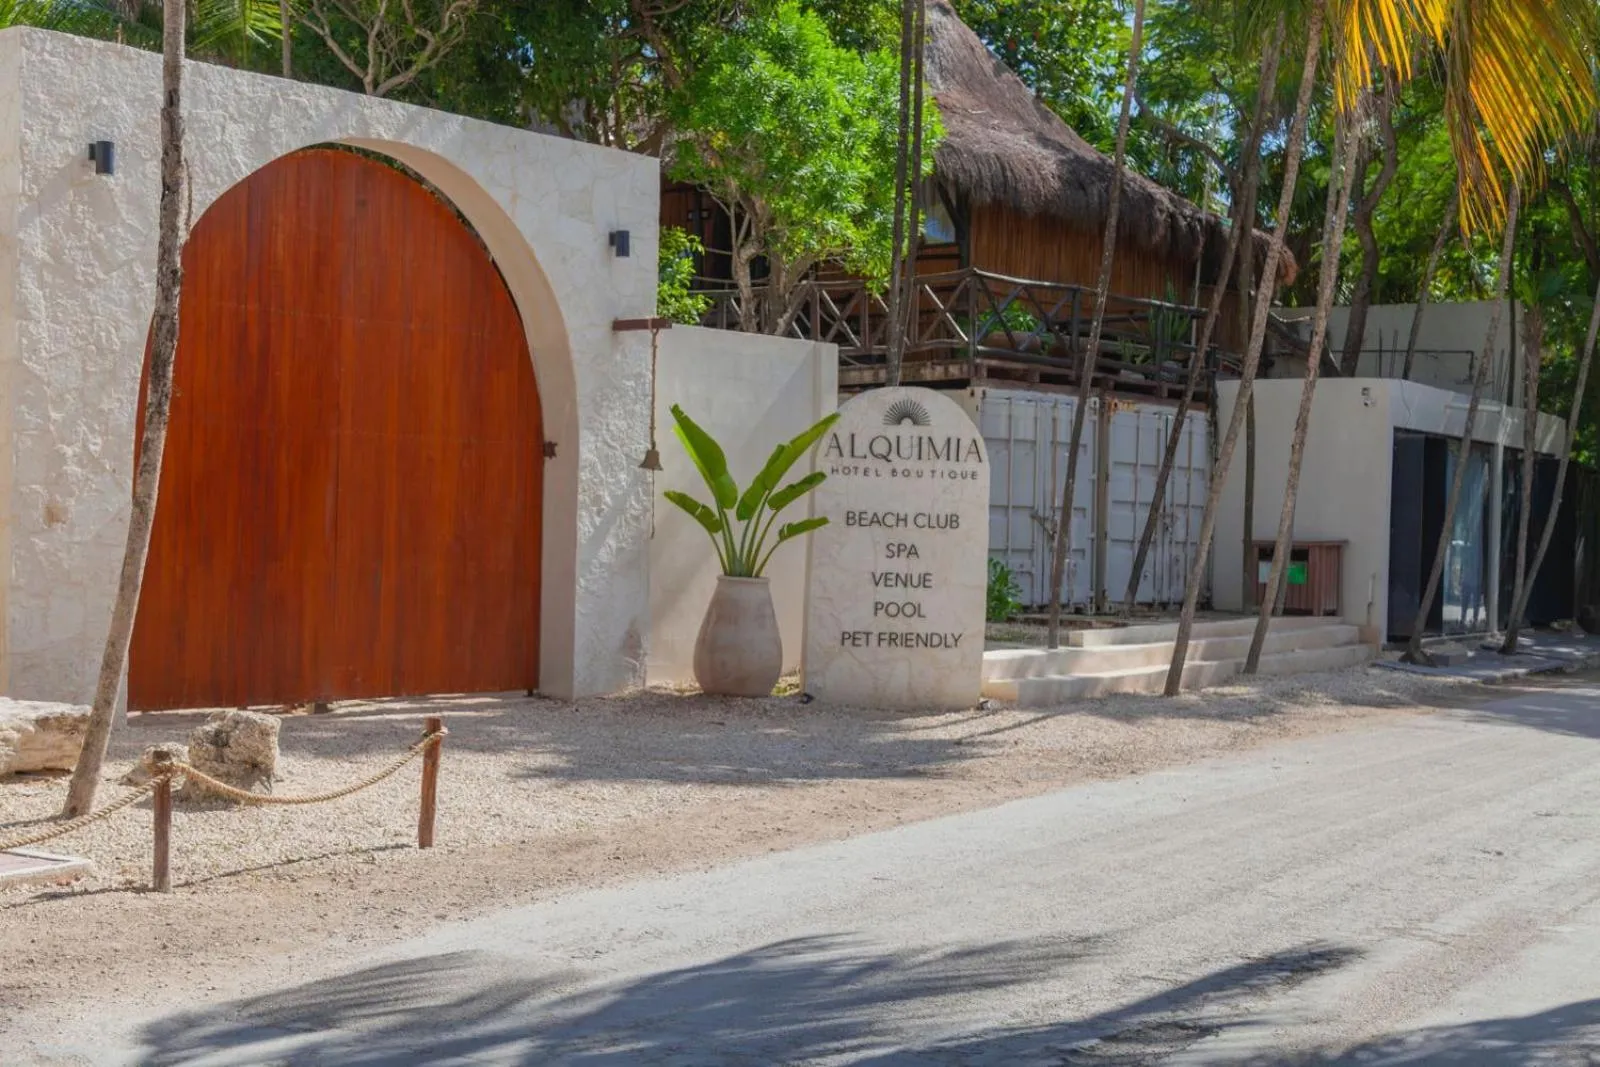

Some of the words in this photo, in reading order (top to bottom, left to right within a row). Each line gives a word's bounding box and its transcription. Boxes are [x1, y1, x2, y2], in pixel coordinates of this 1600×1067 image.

[824, 432, 983, 463] ALQUIMIA
[831, 467, 882, 478] HOTEL
[891, 468, 978, 480] BOUTIQUE
[846, 511, 908, 529] BEACH
[913, 512, 960, 530] CLUB
[885, 543, 920, 559] SPA
[872, 571, 933, 589] VENUE
[873, 601, 926, 618] POOL
[840, 631, 874, 647] PET
[878, 632, 963, 649] FRIENDLY
